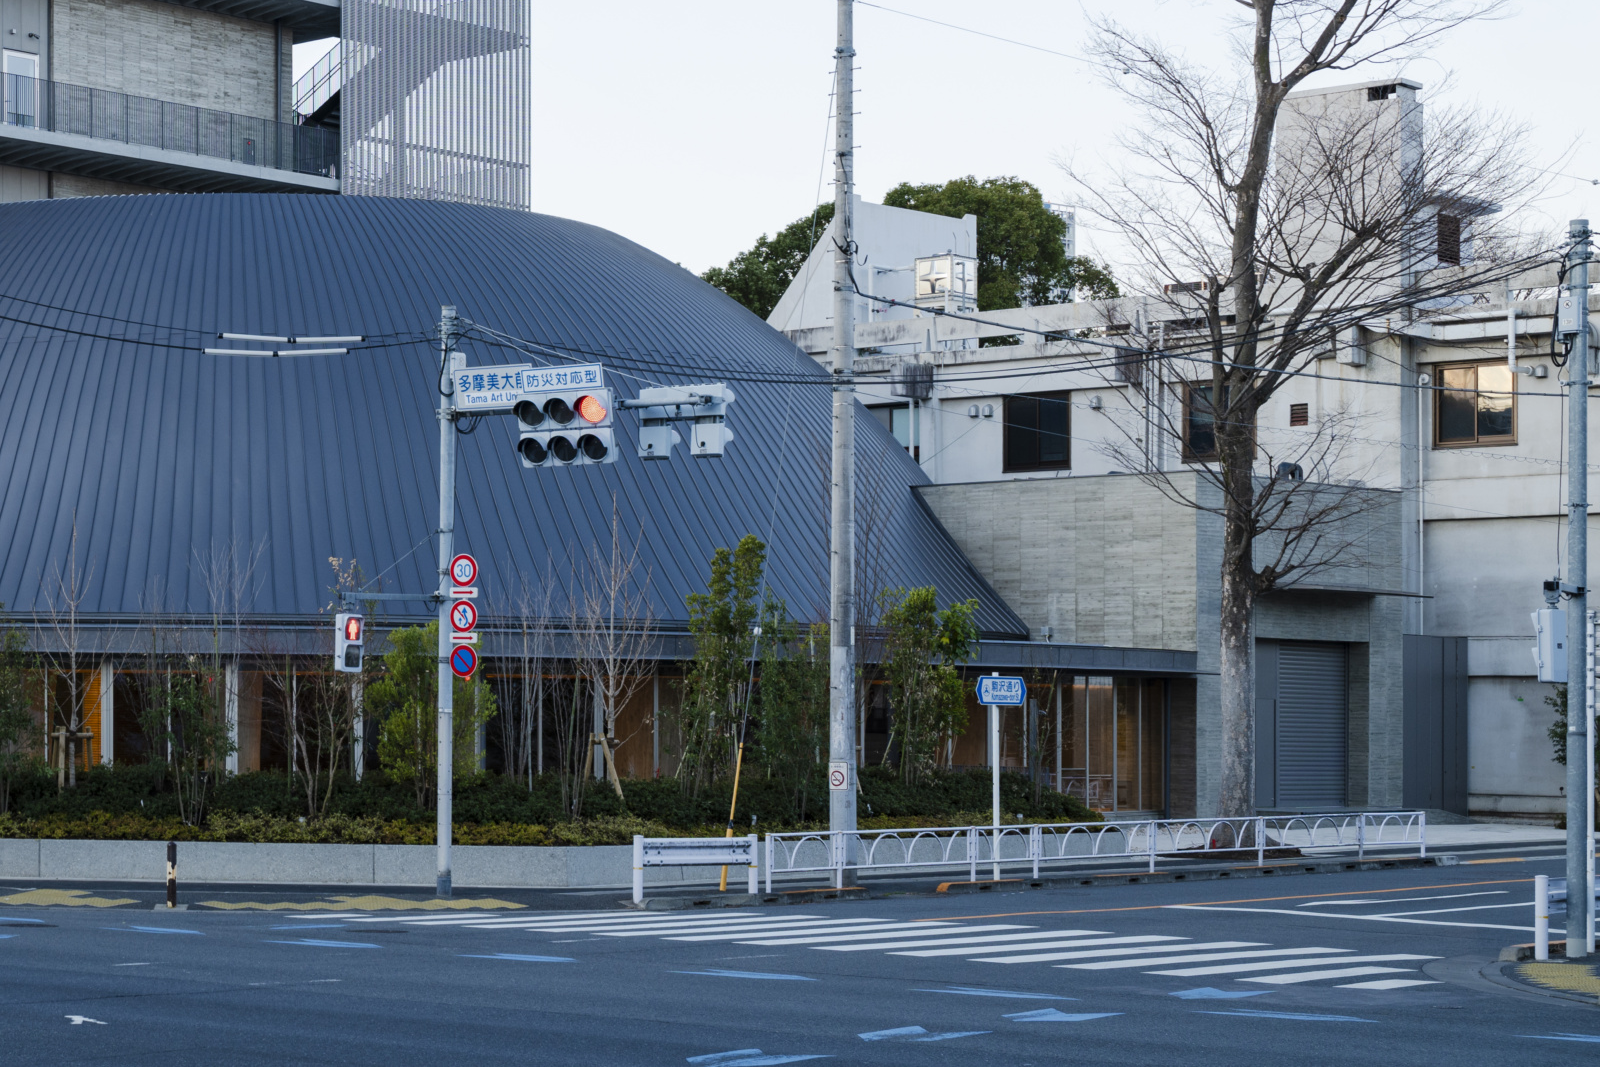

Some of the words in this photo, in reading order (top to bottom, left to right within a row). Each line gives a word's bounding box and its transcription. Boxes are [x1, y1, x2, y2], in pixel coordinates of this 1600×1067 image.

[526, 369, 597, 387] 防災対応型
[466, 394, 488, 404] Tama
[491, 393, 504, 402] Art
[505, 391, 518, 402] Un
[456, 563, 471, 578] 30
[991, 680, 1020, 693] 駒沢通り
